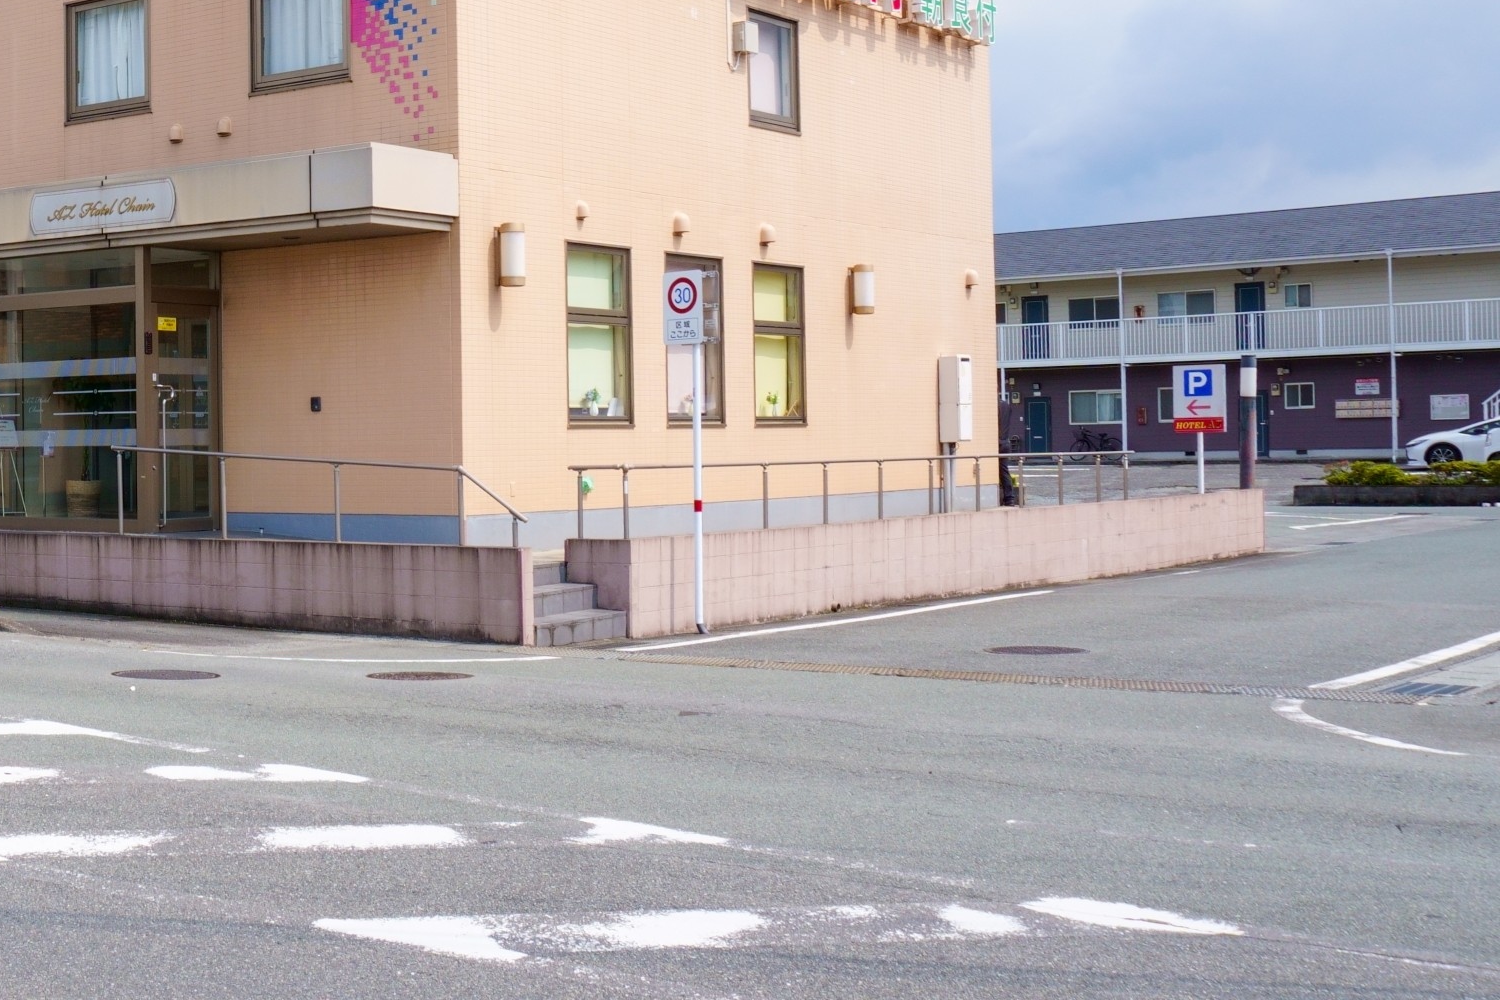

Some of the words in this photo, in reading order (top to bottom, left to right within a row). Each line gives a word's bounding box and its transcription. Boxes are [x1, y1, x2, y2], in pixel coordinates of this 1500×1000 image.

[47, 204, 77, 222] AZ
[79, 199, 118, 218] Hotel
[118, 197, 156, 215] Chain
[674, 287, 691, 304] 30
[670, 330, 697, 339] ここから
[1188, 371, 1208, 395] P
[1175, 421, 1207, 430] HOTEL
[1207, 419, 1222, 429] AZ
